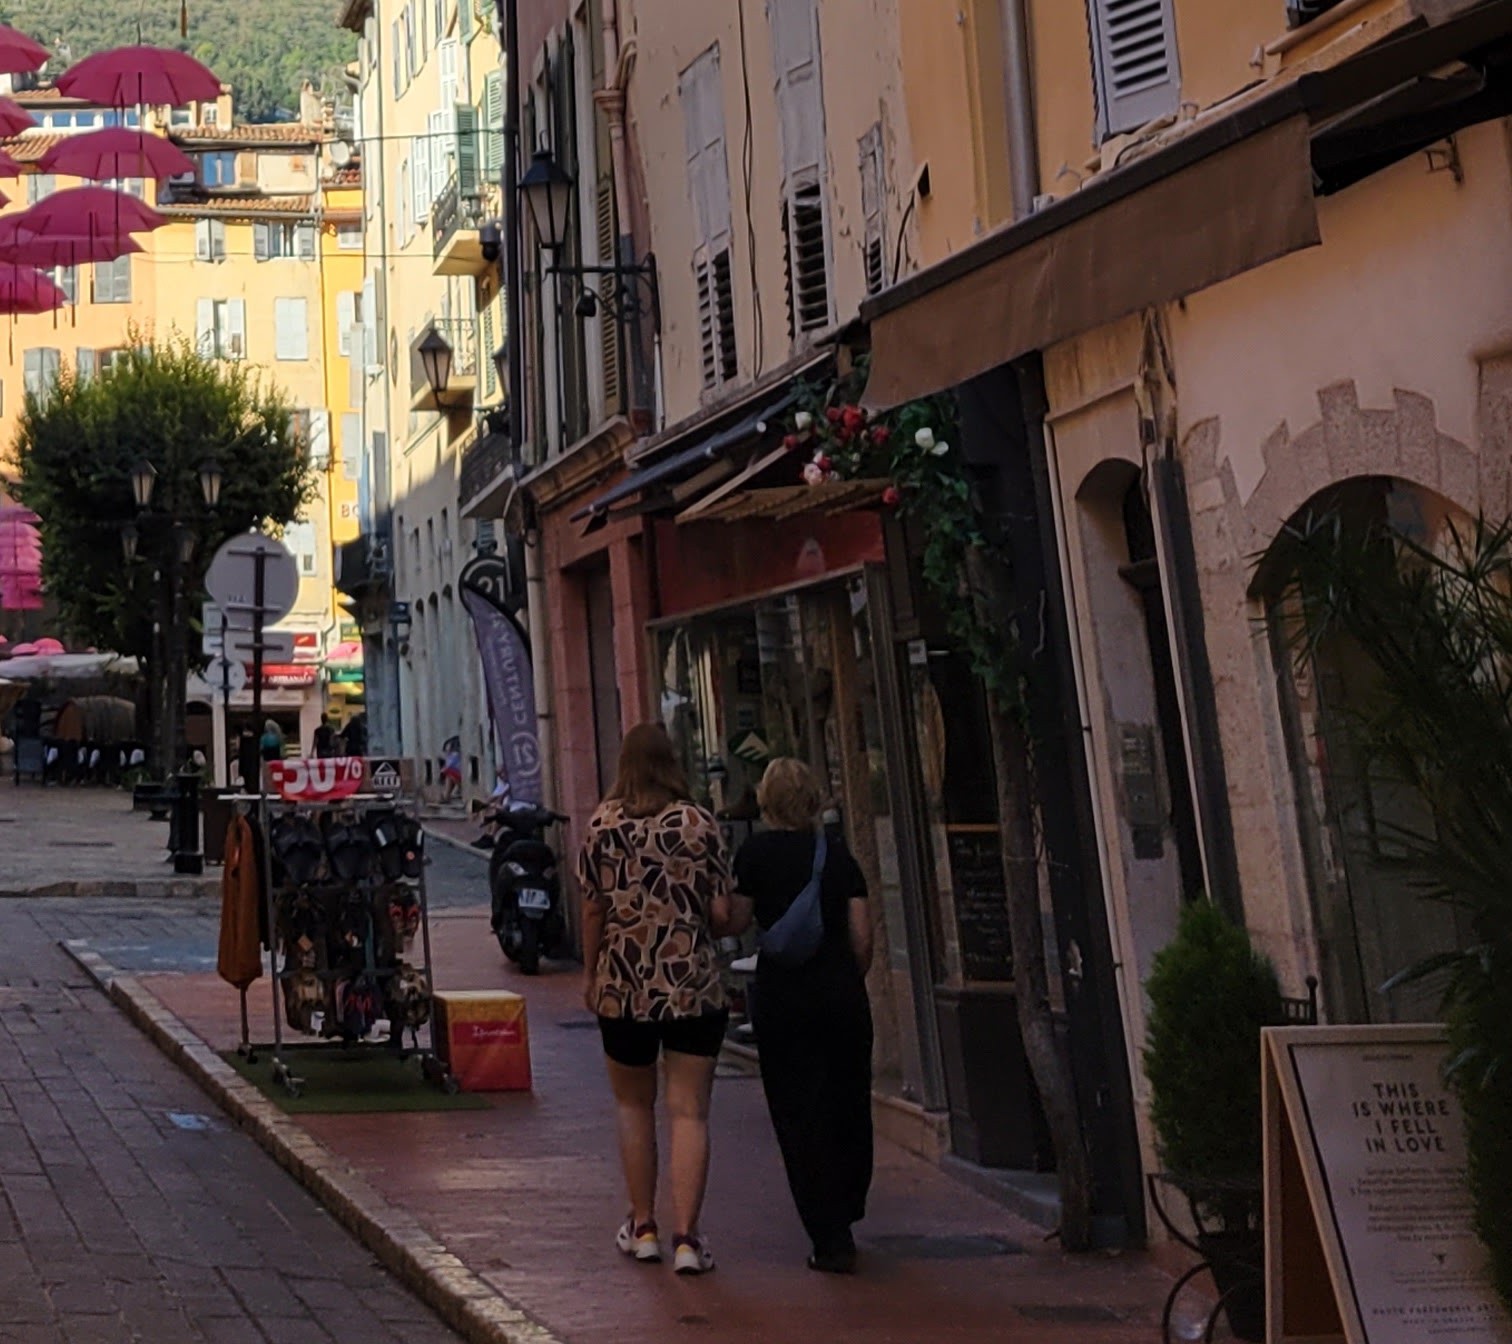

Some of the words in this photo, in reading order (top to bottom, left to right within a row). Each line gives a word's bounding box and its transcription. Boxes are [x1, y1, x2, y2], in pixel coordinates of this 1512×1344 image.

[1373, 1082, 1419, 1098] THIS
[1352, 1102, 1371, 1117] IS
[1378, 1099, 1450, 1116] WHERE
[1376, 1120, 1382, 1134] I
[1391, 1119, 1437, 1134] FELL
[1366, 1137, 1387, 1152] IN
[1394, 1136, 1445, 1152] LOVE
